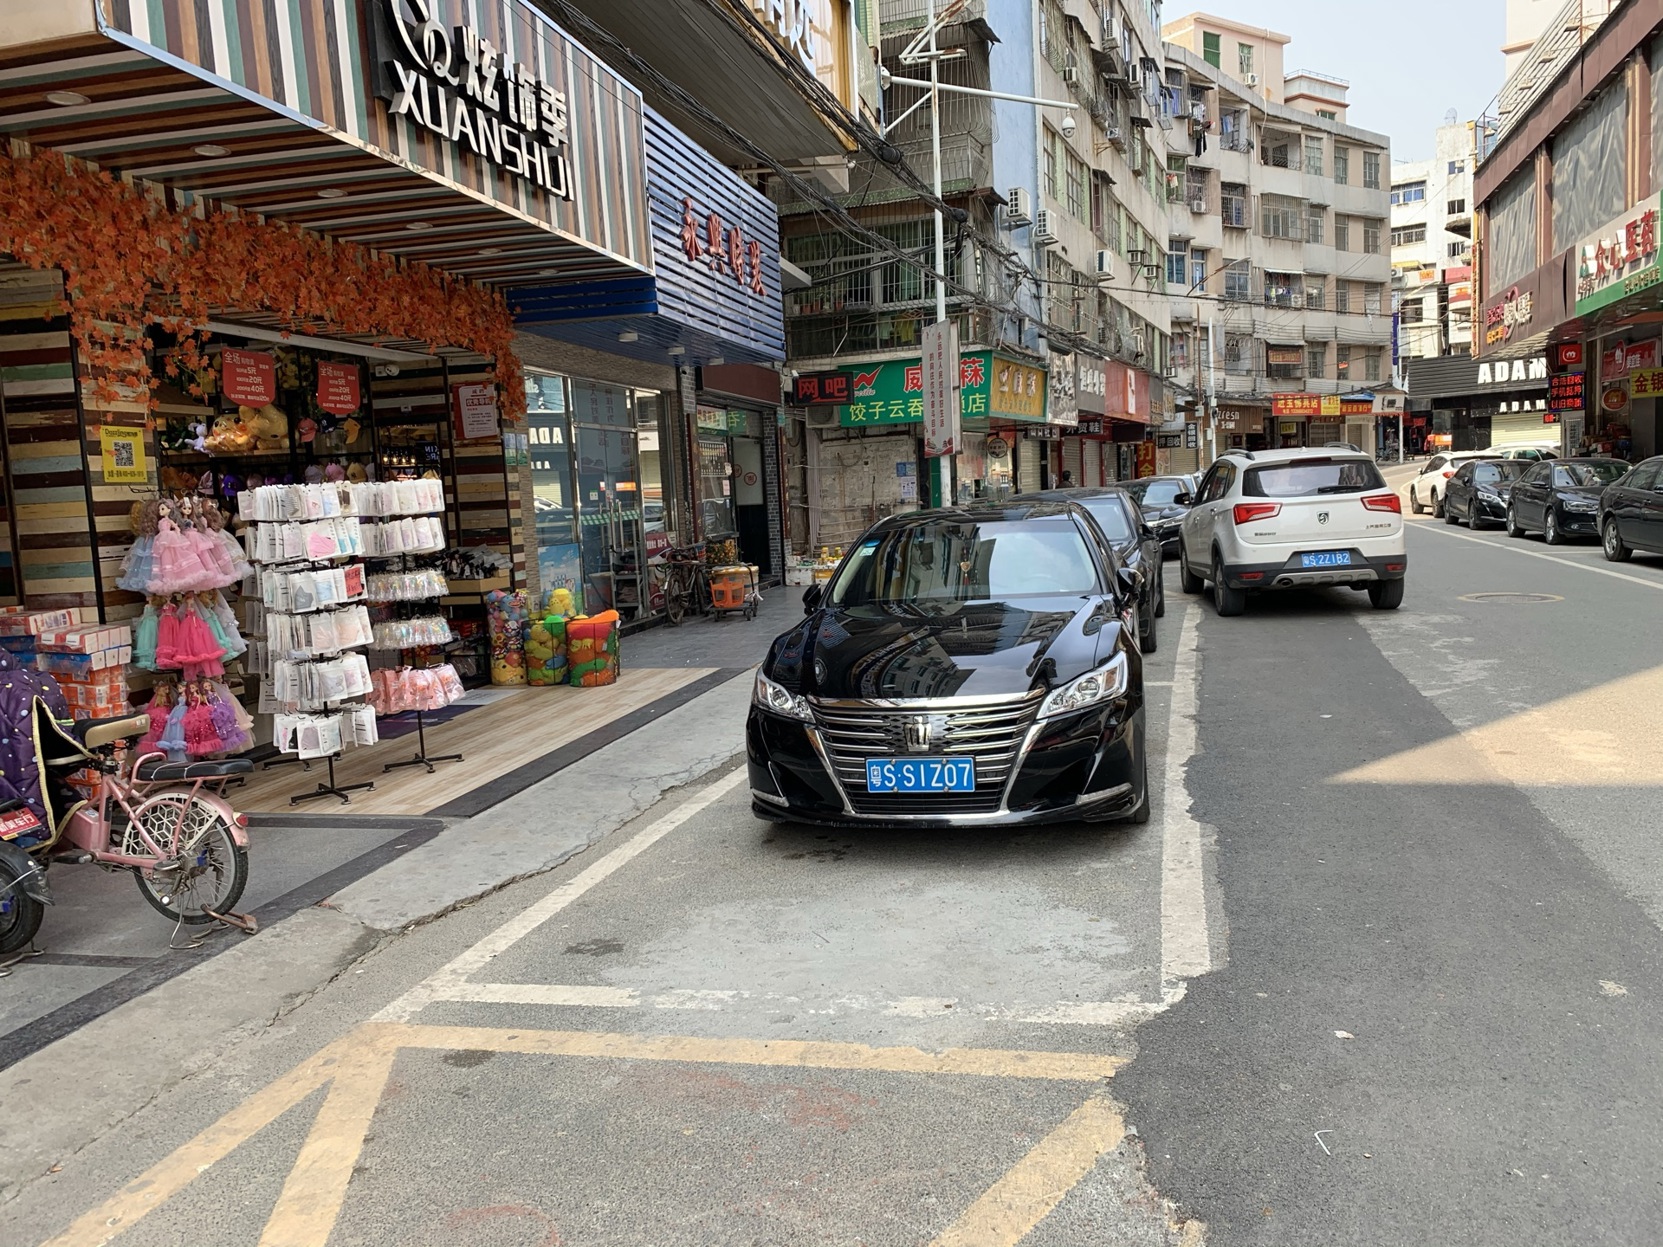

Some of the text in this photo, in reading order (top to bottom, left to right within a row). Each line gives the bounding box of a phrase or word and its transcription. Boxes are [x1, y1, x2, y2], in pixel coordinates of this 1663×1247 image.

[456, 25, 569, 147] 炫饰季
[1477, 357, 1547, 384] ADAM
[797, 377, 849, 399] 网吧
[849, 393, 987, 421] 饺子云吞店
[1499, 399, 1546, 413] ADAM
[870, 763, 971, 788] 粤S·S1Z07
